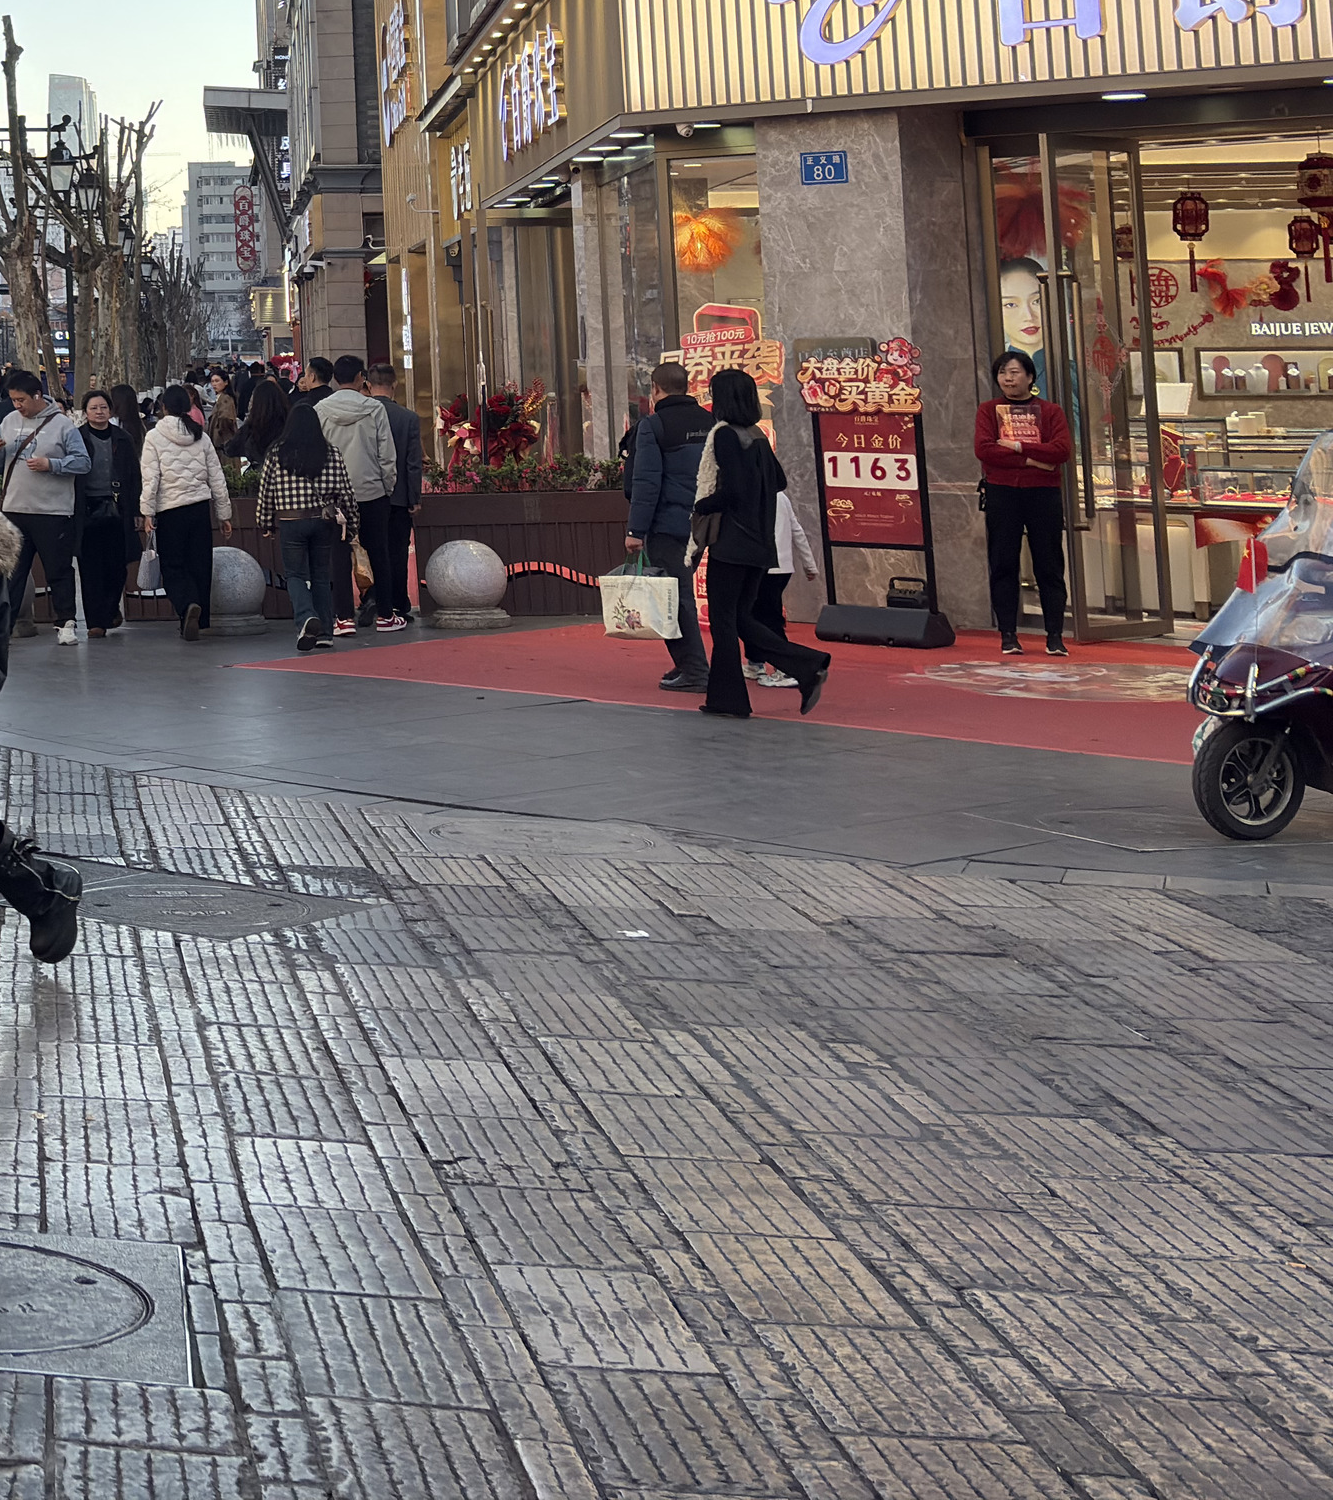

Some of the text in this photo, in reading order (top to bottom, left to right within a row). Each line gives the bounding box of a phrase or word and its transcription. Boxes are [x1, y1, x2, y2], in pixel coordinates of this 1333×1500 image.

[806, 155, 841, 165] 正义路
[814, 165, 835, 180] 80
[238, 199, 253, 258] 百爵珠宝
[686, 328, 745, 345] 10元抢100元
[1251, 322, 1301, 336] BAIJUE
[797, 357, 878, 383] 大盘金价
[836, 381, 921, 411] 买黄金
[835, 433, 902, 449] 今日金价
[827, 455, 912, 481] 1163
